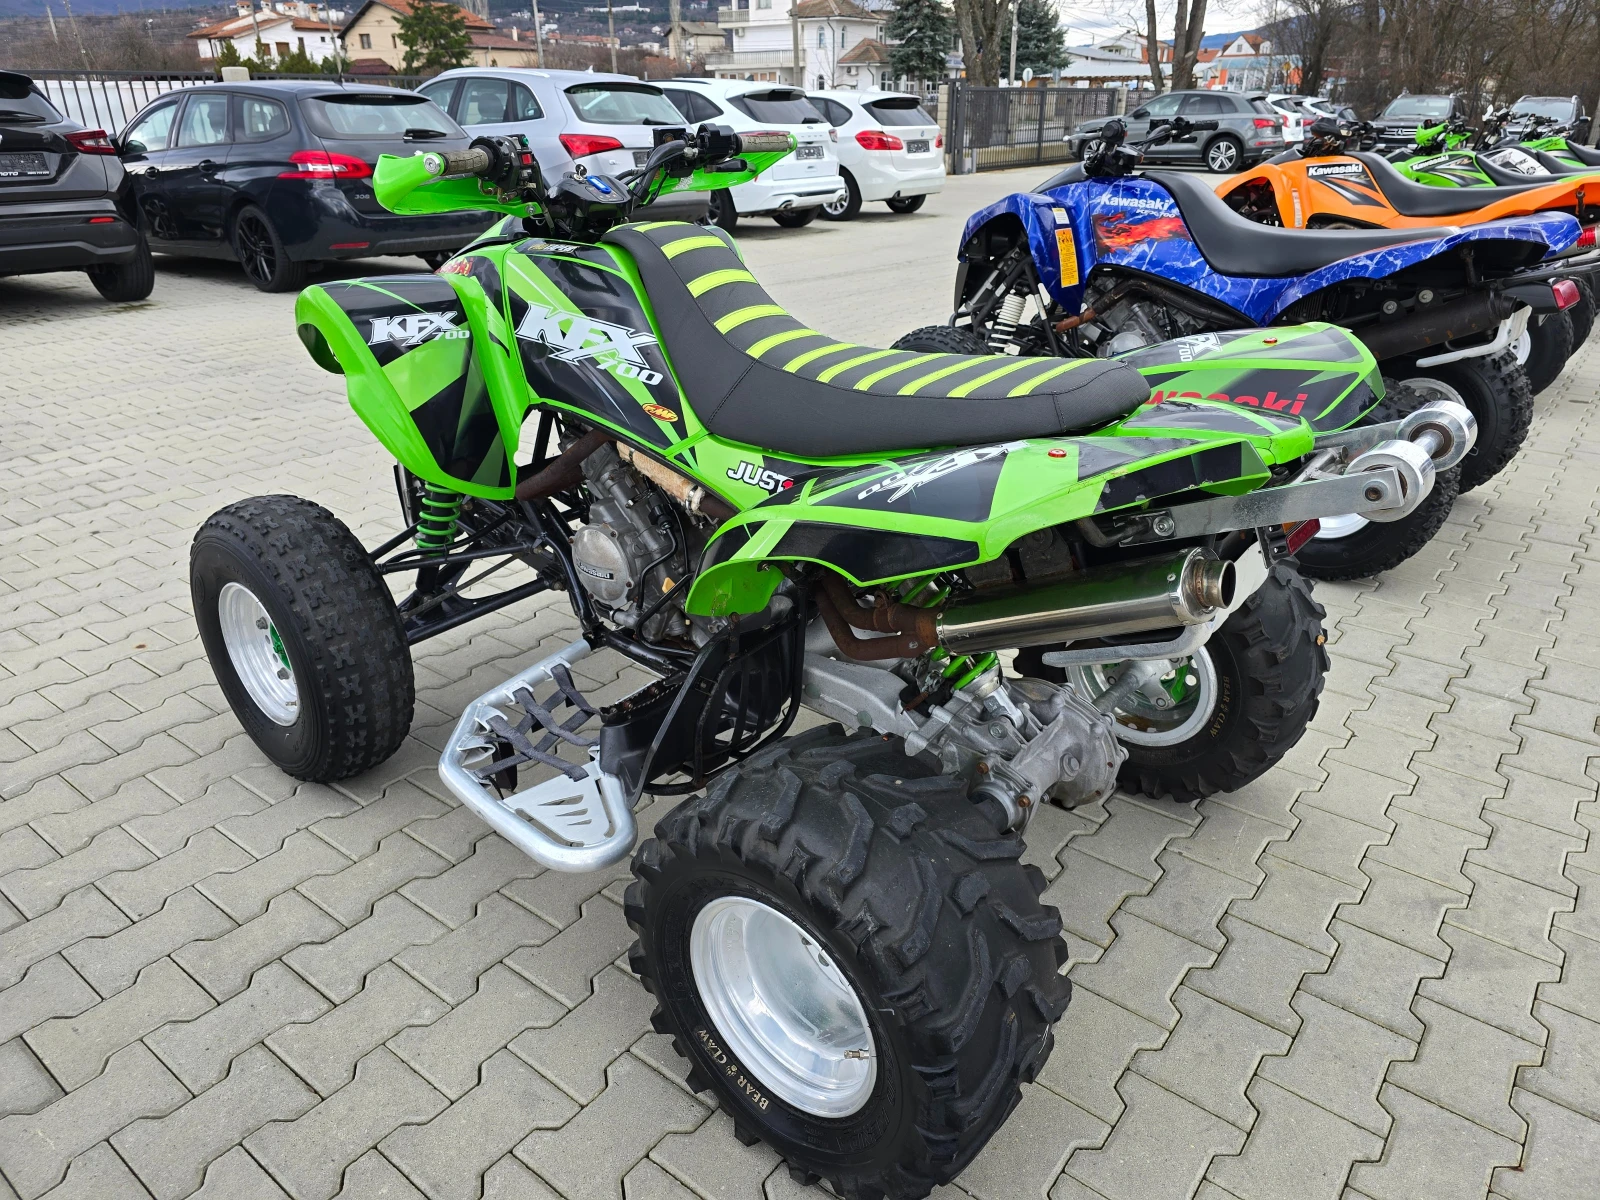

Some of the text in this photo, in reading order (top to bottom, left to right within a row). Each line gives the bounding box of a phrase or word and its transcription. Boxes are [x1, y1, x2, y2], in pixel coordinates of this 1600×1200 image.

[1308, 164, 1362, 176] Kawasaki
[1100, 194, 1169, 211] Kawasaki
[368, 311, 461, 346] KFX
[430, 329, 470, 340] 700
[515, 301, 658, 367] KFX
[1177, 343, 1193, 362] 700
[597, 358, 663, 386] 700
[1209, 712, 1226, 738] CLAW
[697, 1029, 769, 1110] BEAR CLAW
